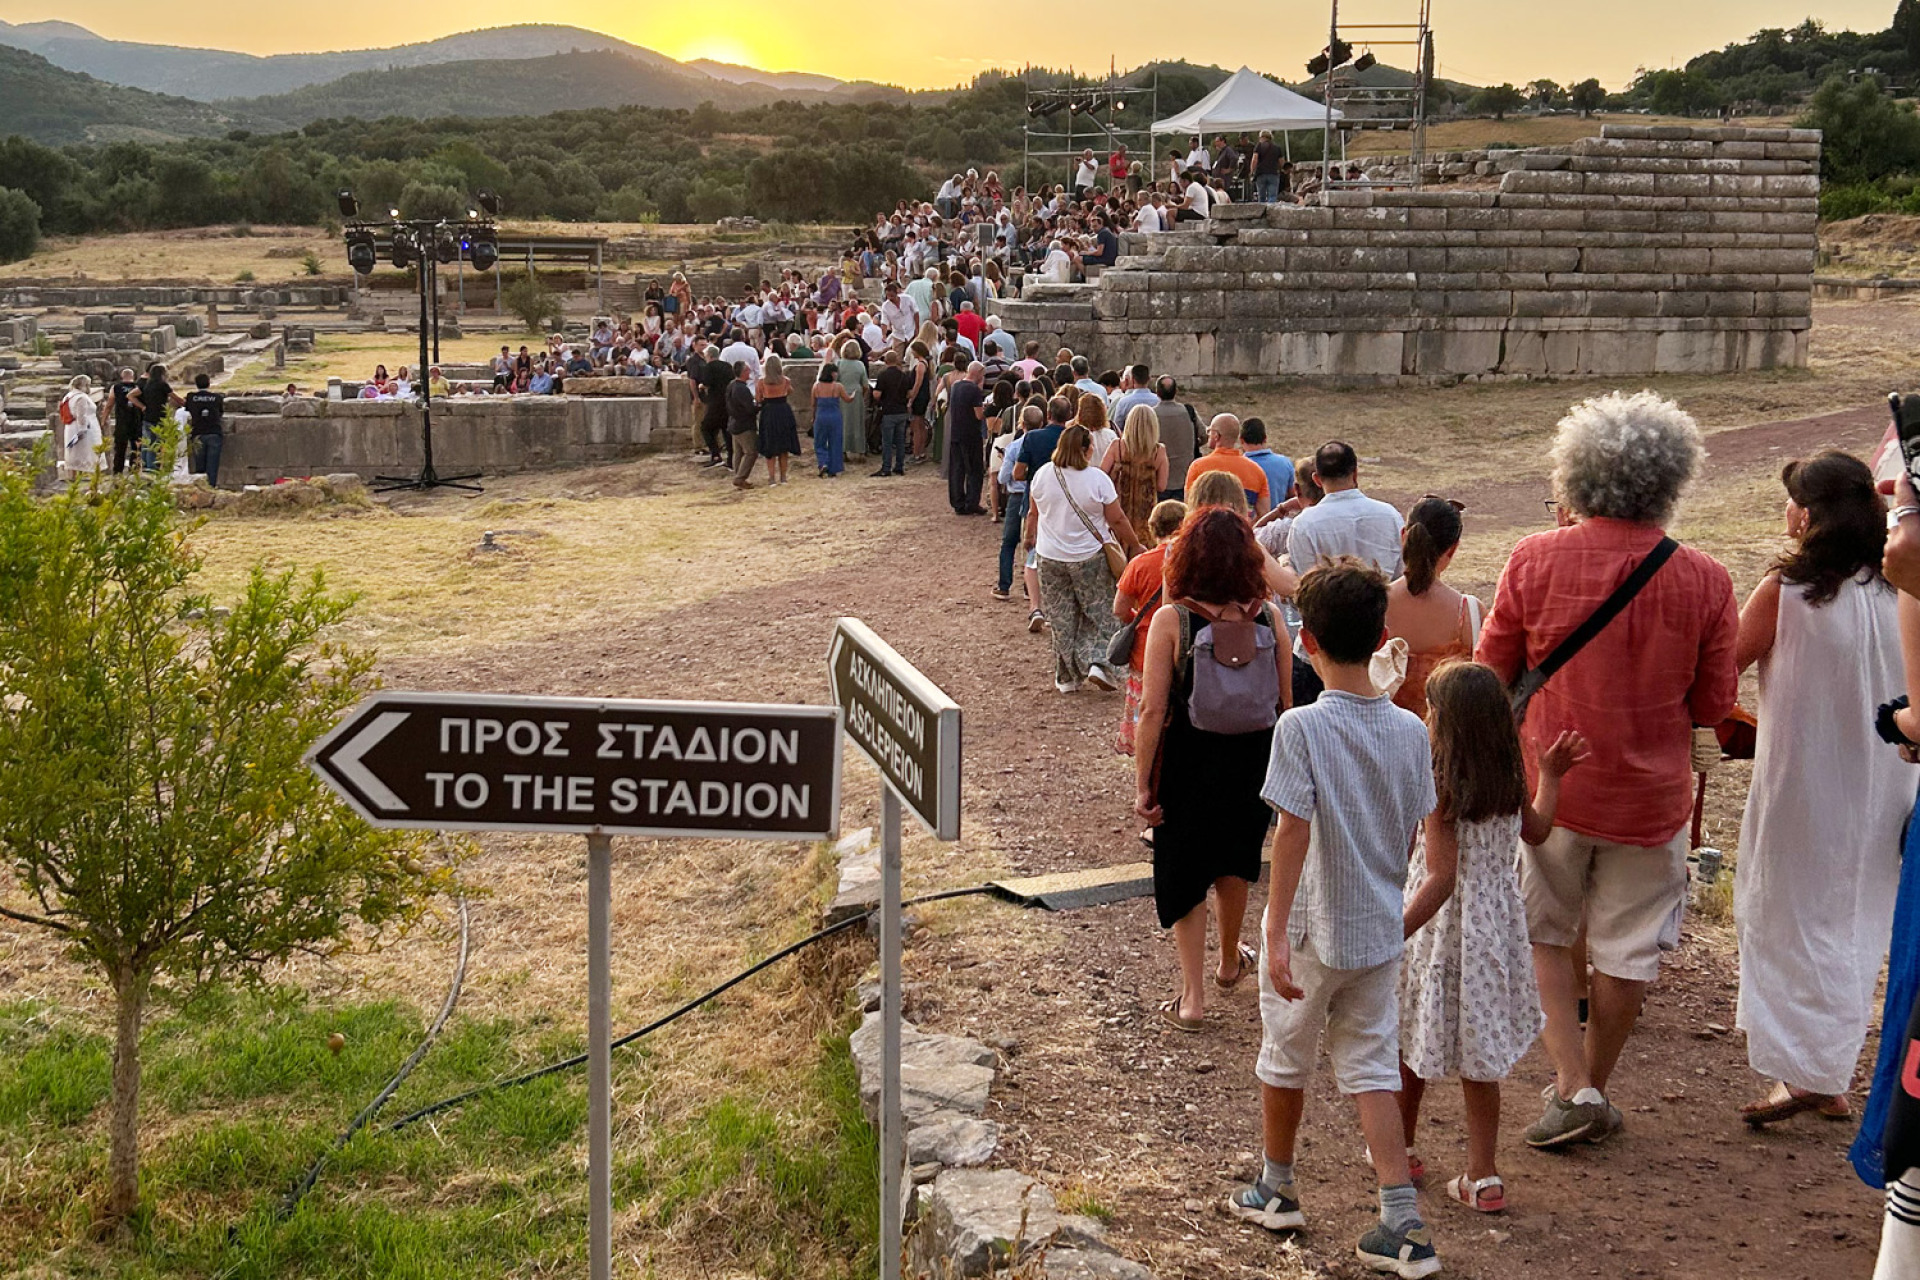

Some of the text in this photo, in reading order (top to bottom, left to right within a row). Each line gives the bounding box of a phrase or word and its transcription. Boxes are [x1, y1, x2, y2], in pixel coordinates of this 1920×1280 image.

[850, 650, 924, 751] ΑΣΚΛΗΠΙΕΙΟΝ
[440, 717, 800, 765] ΠΡΟΣ ΣΤΑΔΙΟΝ
[850, 696, 923, 800] ASCLEPIEION
[426, 772, 810, 819] TO THE STADION
